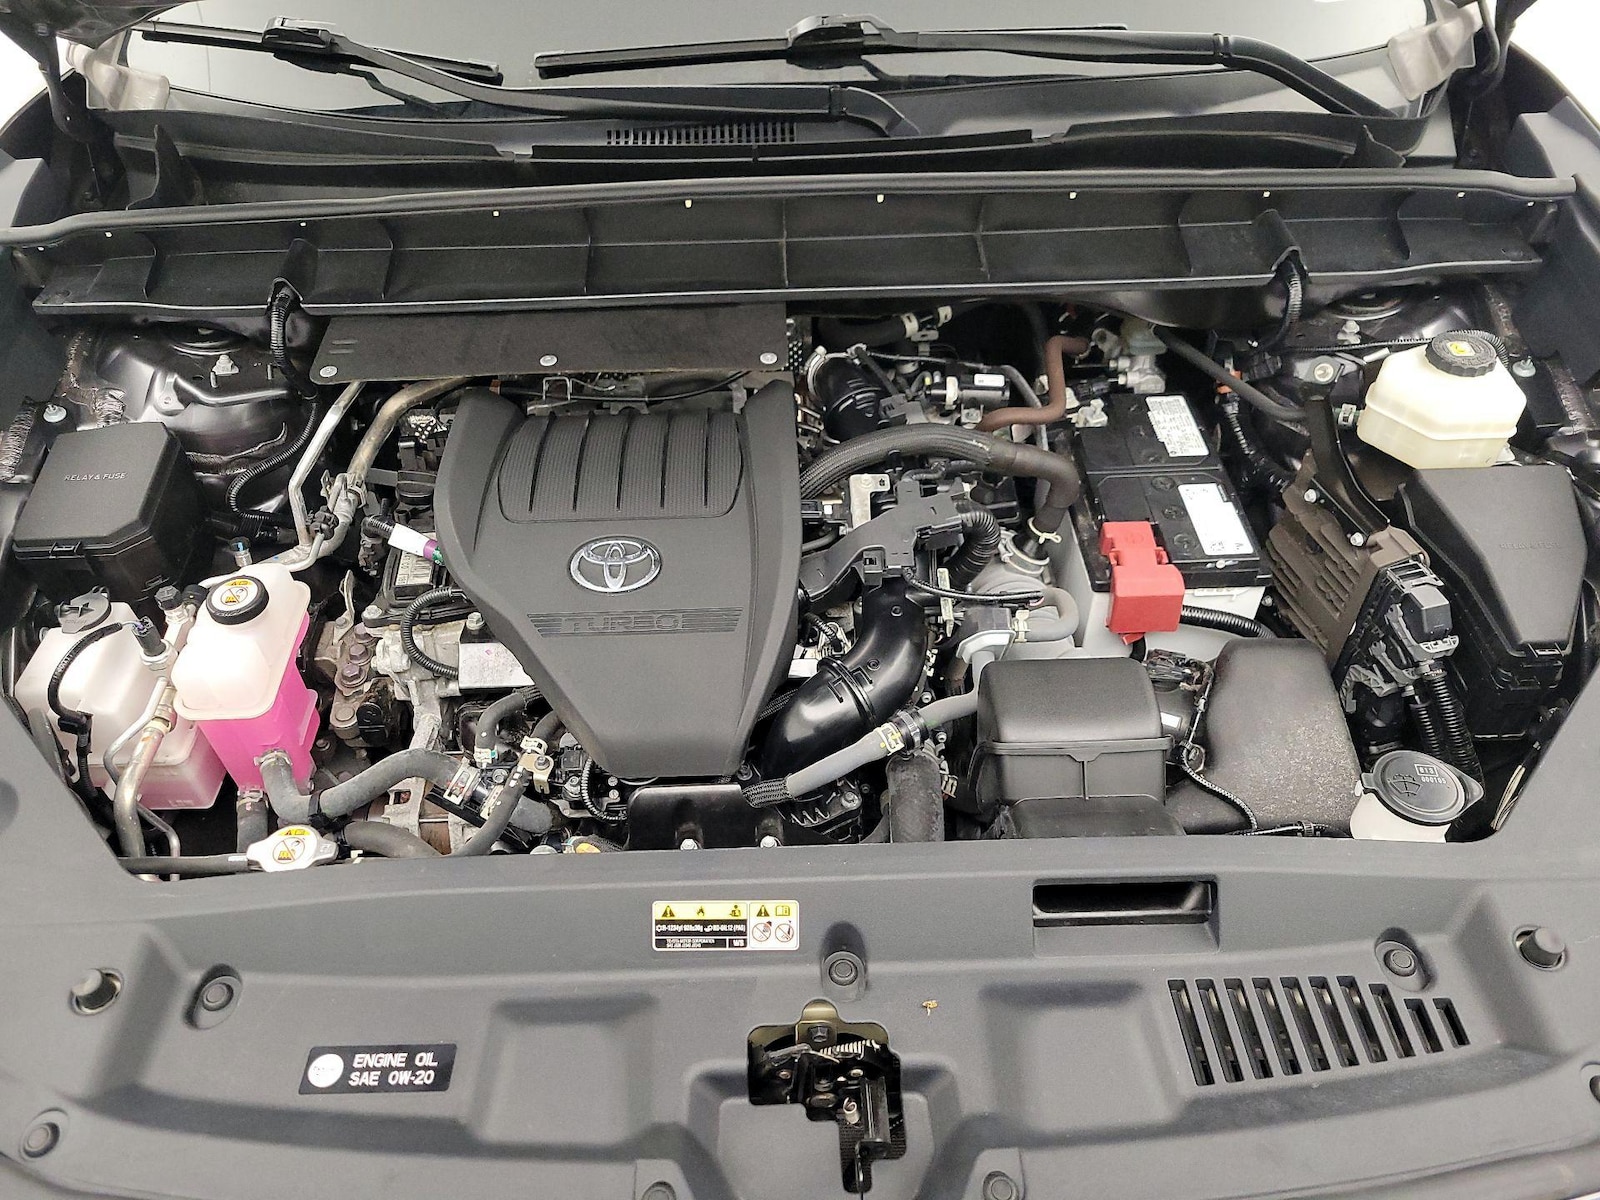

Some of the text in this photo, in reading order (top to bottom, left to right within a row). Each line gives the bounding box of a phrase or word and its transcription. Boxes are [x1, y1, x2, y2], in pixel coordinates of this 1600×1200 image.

[64, 473, 94, 481] RELAY
[102, 471, 128, 480] FUSE
[564, 613, 680, 633] TURBO
[352, 1051, 438, 1069] ENGINE OIL
[348, 1070, 381, 1086] SAE
[388, 1069, 435, 1086] 0W-20
